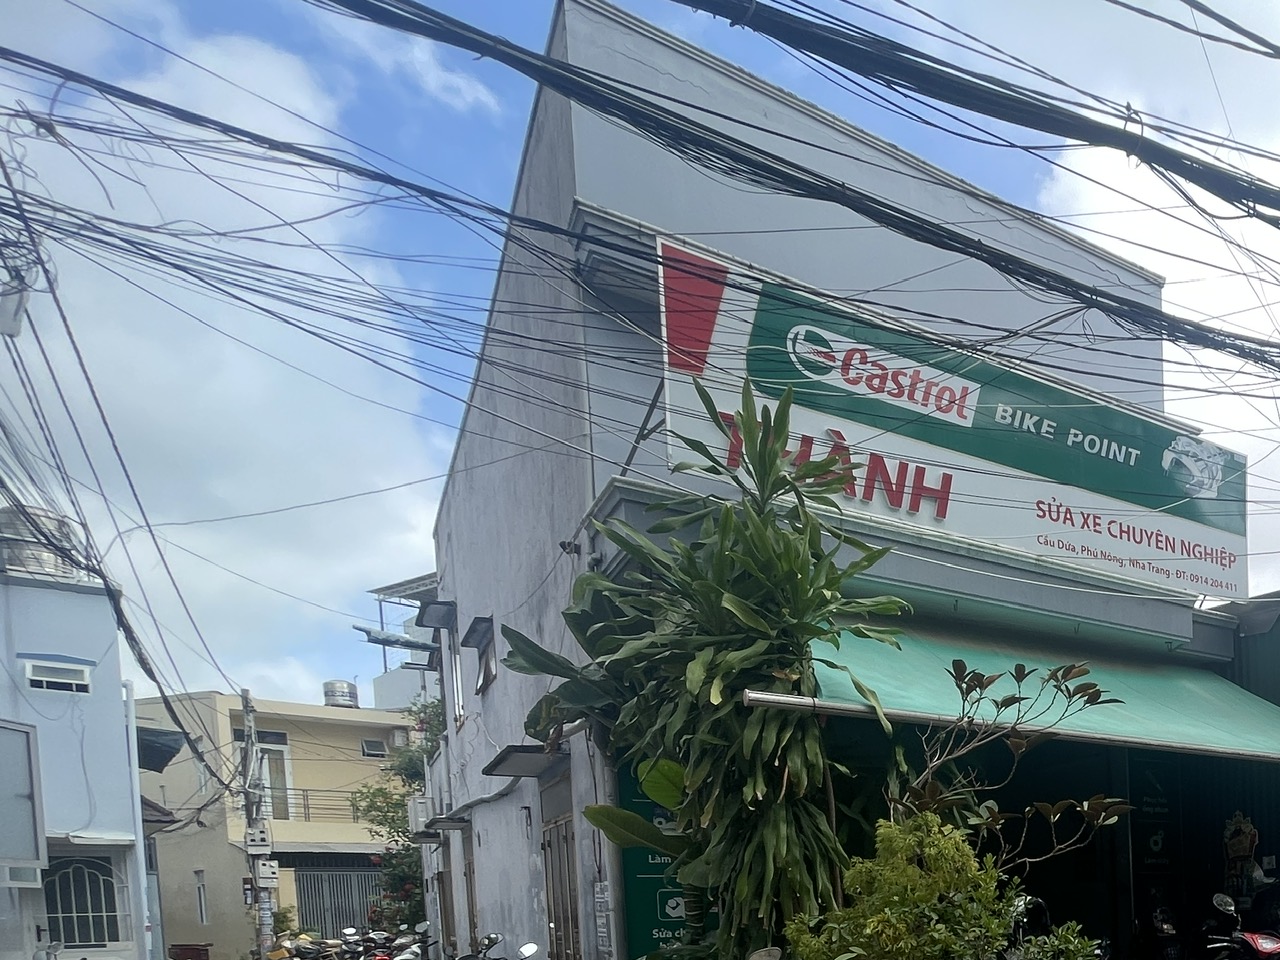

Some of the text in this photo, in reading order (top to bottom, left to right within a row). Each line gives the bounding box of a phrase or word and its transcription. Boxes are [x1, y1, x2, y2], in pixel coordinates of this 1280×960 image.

[841, 347, 969, 421] Castrol
[994, 403, 1141, 466] BIKE POINT
[1035, 497, 1237, 571] SỬA XE CHUYÊN NGHIỆP
[1081, 545, 1098, 558] Phú
[1129, 558, 1146, 570] Nha
[1189, 574, 1208, 585] 0914
[1210, 578, 1223, 589] 204
[1224, 582, 1238, 592] 411
[648, 855, 671, 863] Làm
[652, 928, 672, 938] Sửa
